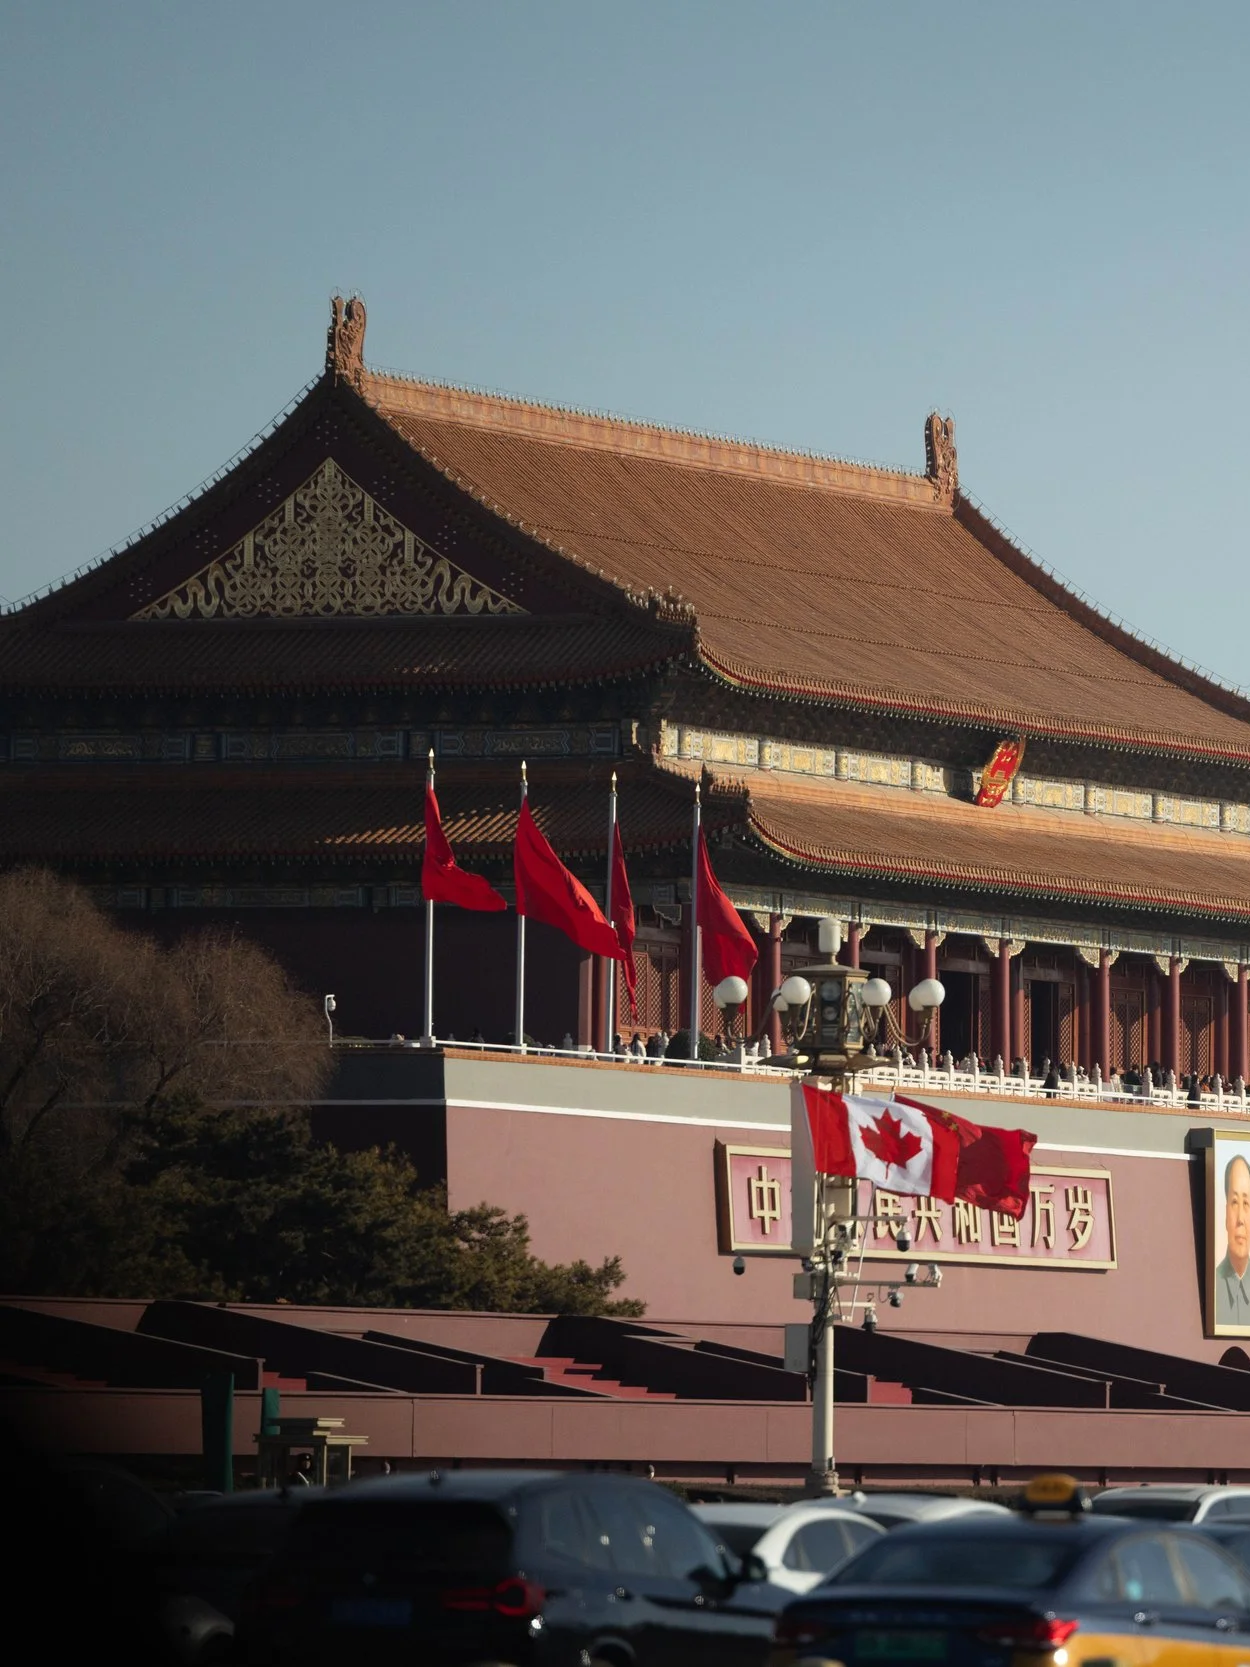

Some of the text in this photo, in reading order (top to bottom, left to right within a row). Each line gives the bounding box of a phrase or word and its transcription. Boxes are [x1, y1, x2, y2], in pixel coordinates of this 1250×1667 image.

[748, 1165, 1093, 1251] 中民共和国万岁
